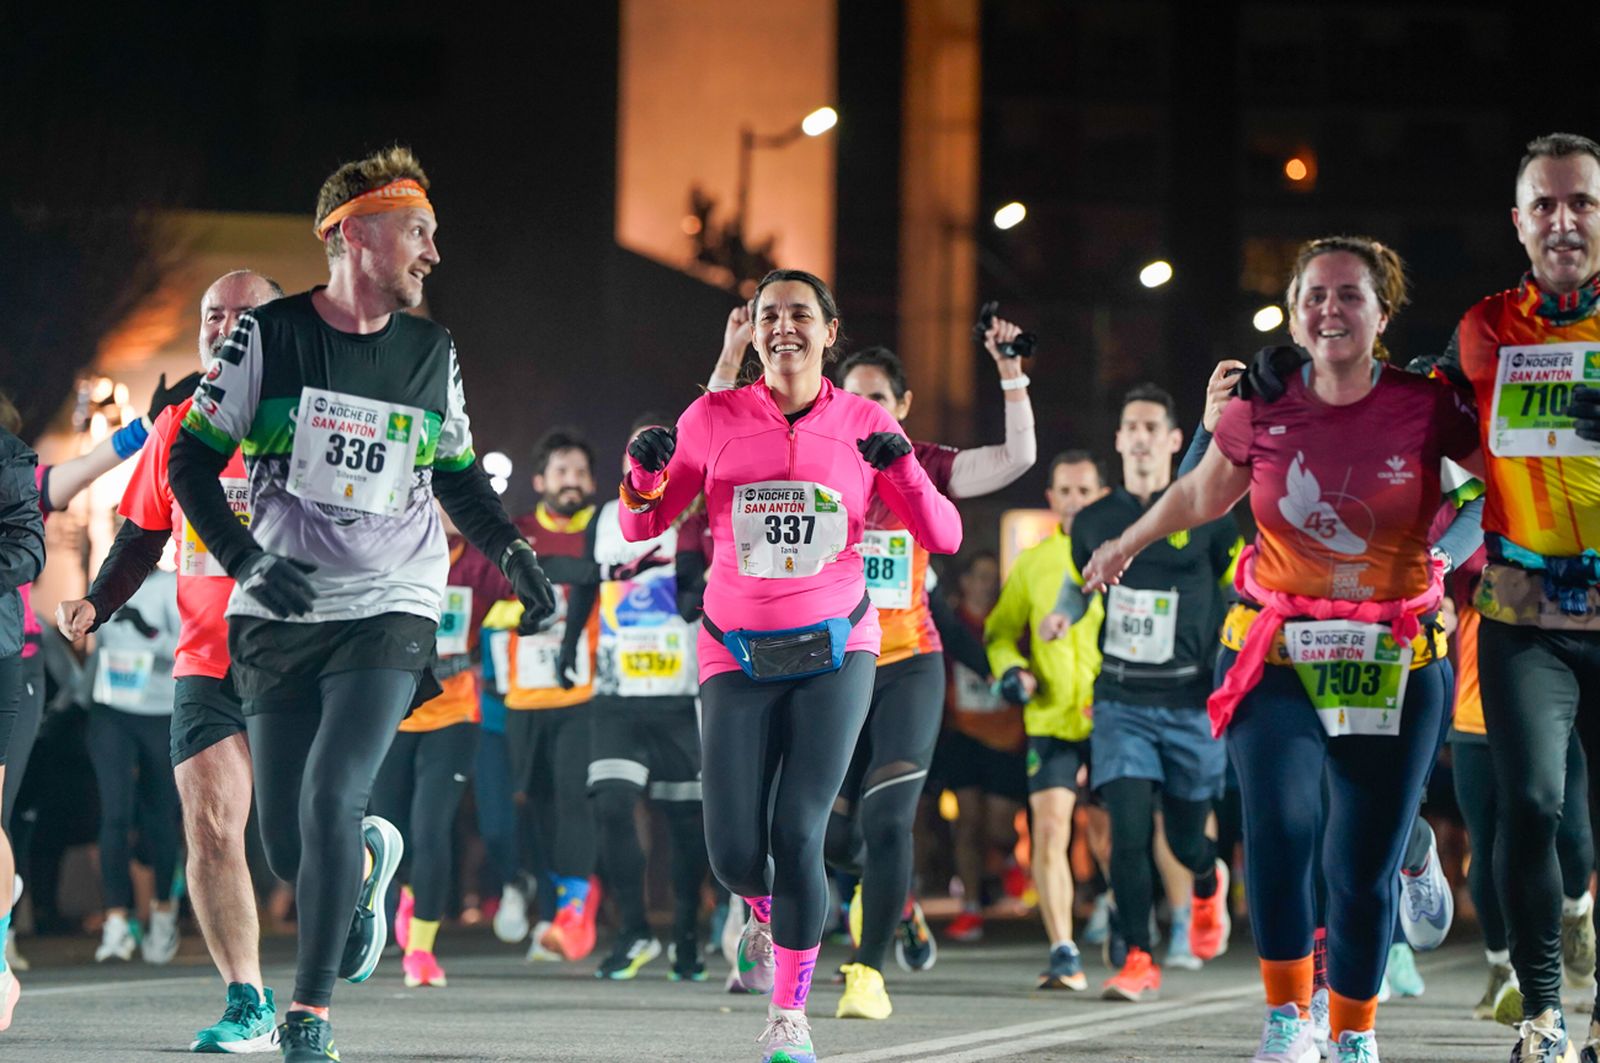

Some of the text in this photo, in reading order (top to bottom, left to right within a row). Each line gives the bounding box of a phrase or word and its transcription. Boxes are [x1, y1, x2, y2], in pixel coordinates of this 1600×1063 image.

[1525, 356, 1574, 368] NOCHE DE
[1510, 371, 1534, 382] SAN
[1520, 383, 1588, 417] 710
[328, 405, 364, 421] NOCHE
[365, 412, 379, 424] DE
[312, 416, 337, 430] SAN
[338, 422, 376, 438] ANTÓN
[325, 433, 387, 474] 336
[757, 491, 805, 501] NOCHE DE
[744, 503, 767, 514] SAN
[768, 500, 805, 513] ANTÓN
[764, 515, 816, 545] 337
[1303, 511, 1338, 539] 43
[780, 547, 799, 555] Tania
[863, 556, 895, 580] 88
[1315, 633, 1366, 646] NOCHE DE
[1301, 649, 1326, 661] SAN
[1312, 662, 1383, 697] 7503
